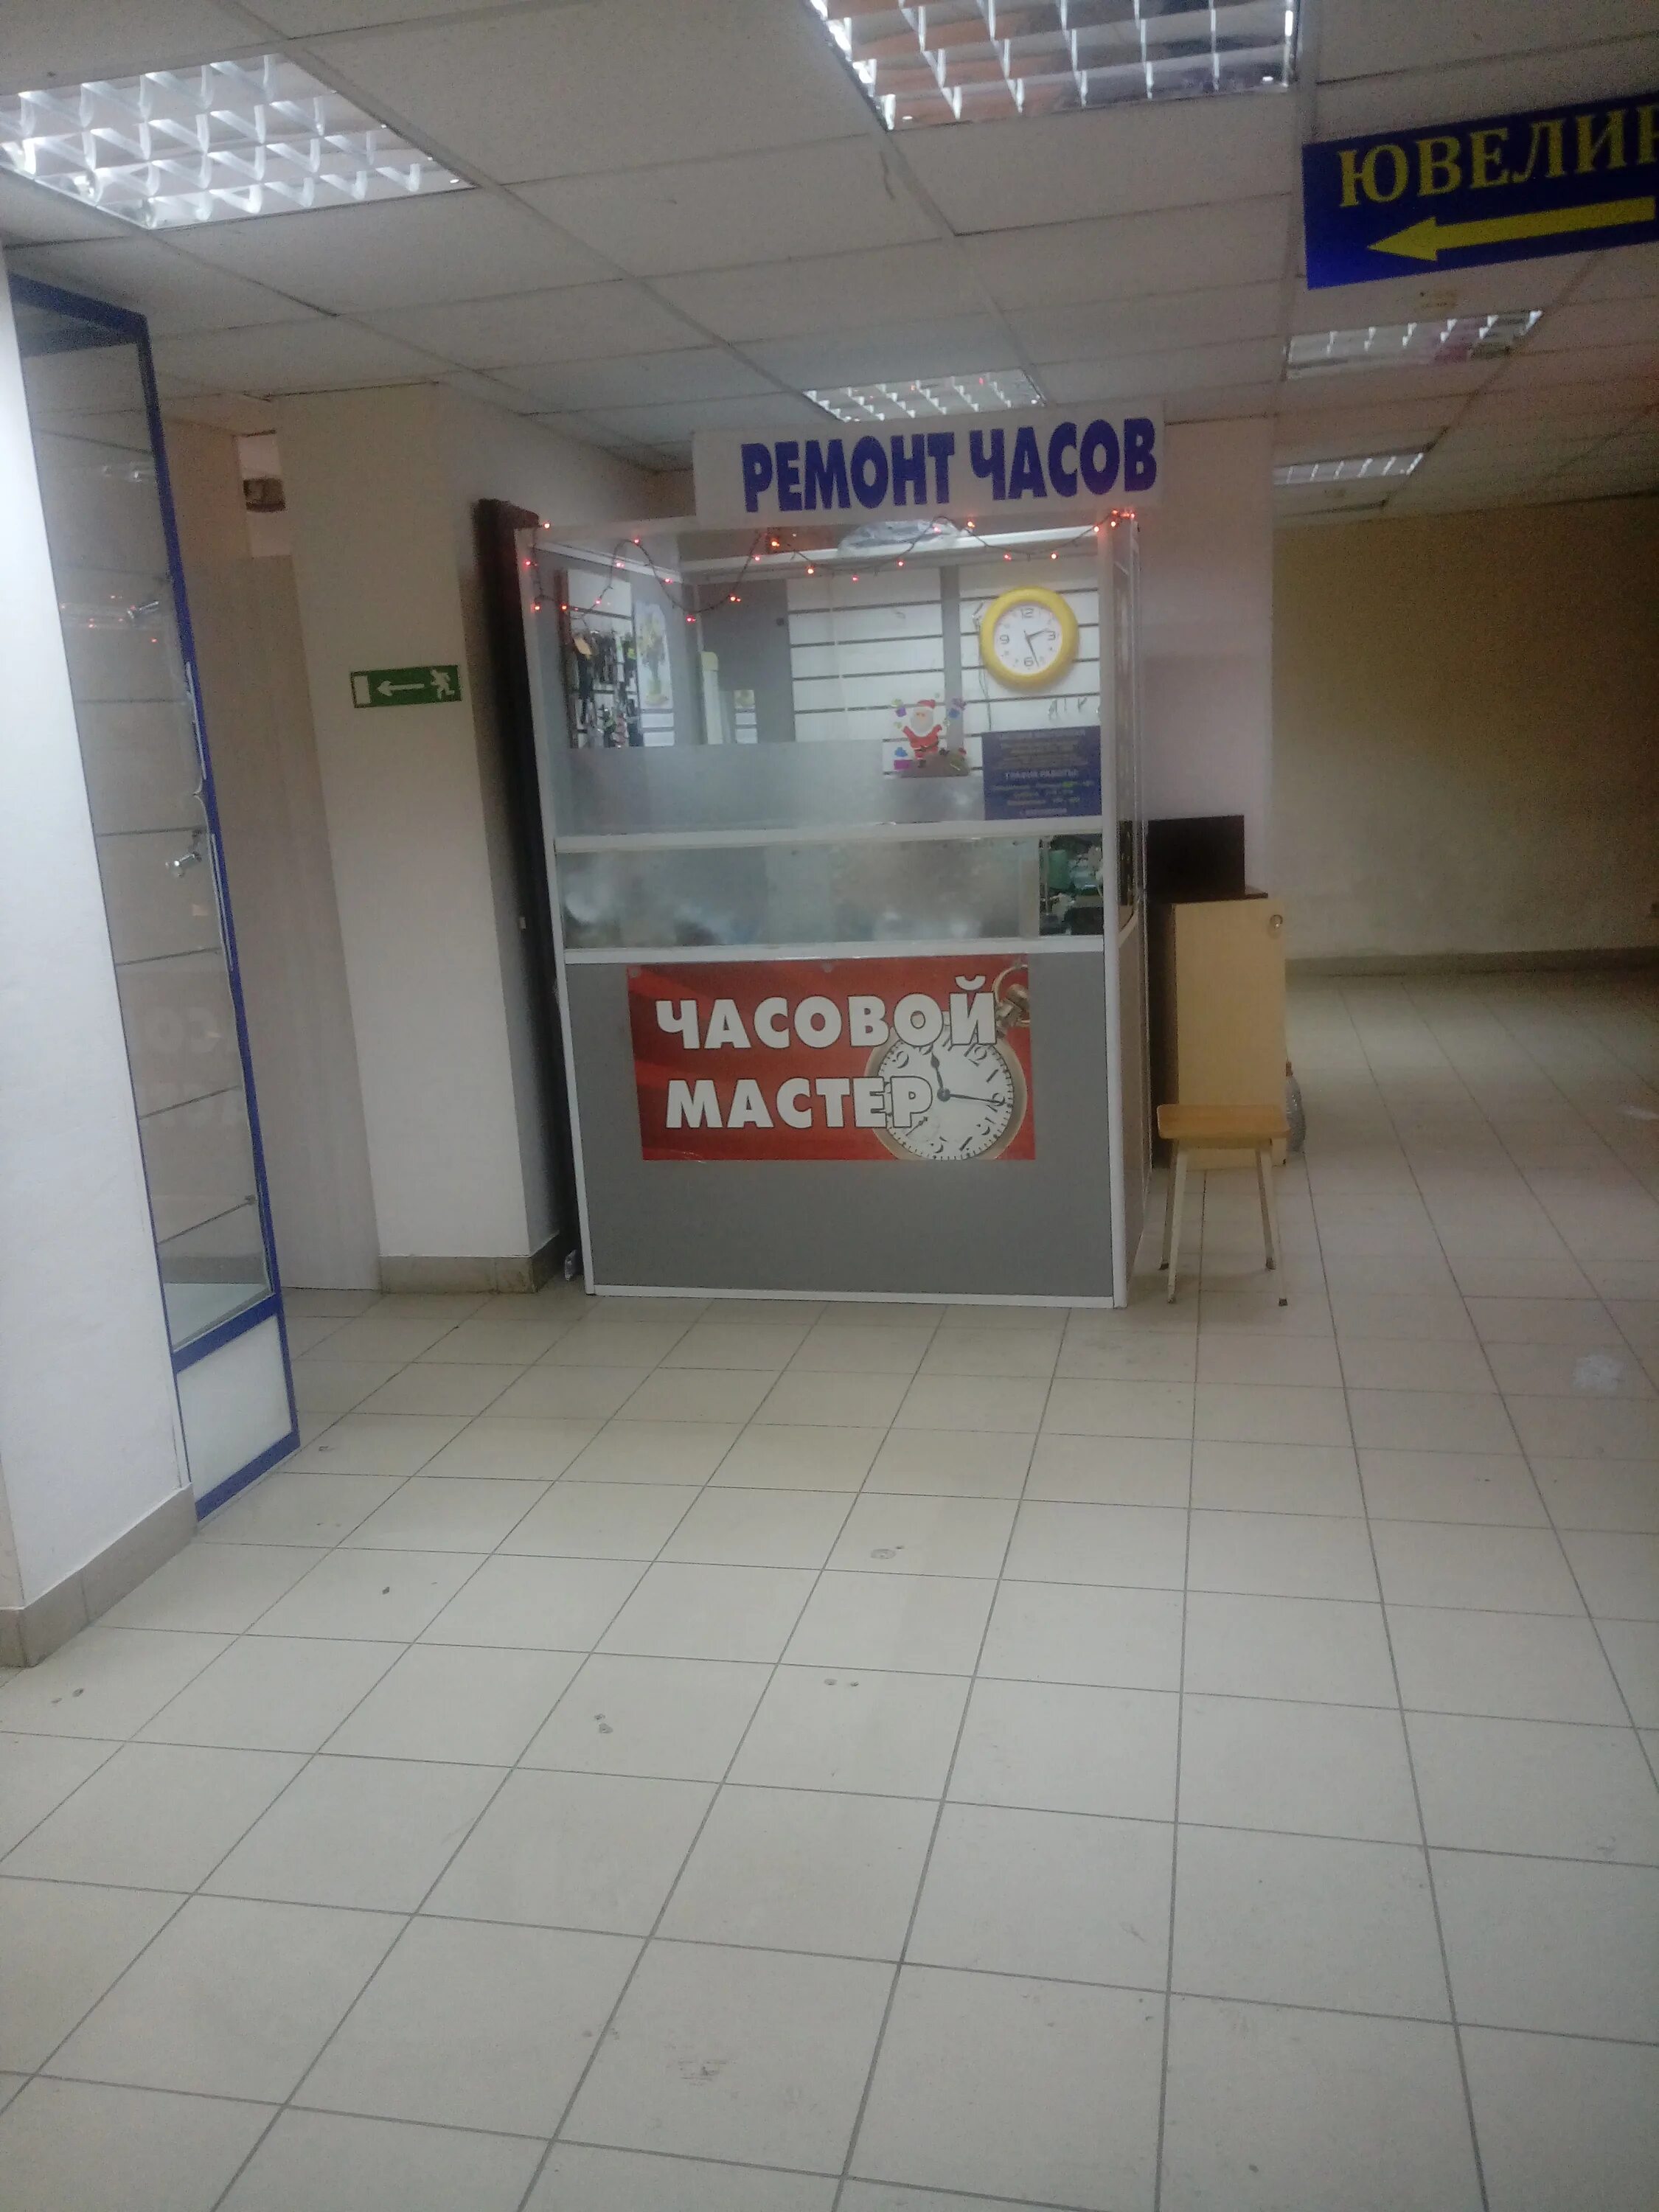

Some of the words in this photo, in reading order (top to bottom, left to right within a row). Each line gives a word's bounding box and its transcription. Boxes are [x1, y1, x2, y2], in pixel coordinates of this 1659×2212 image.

[741, 432, 956, 512] РЕМОНТ
[969, 417, 1157, 501] ЧАСОВ
[655, 975, 998, 1049] ЧАСОВОЙ
[666, 1076, 934, 1129] МАСТЕР
